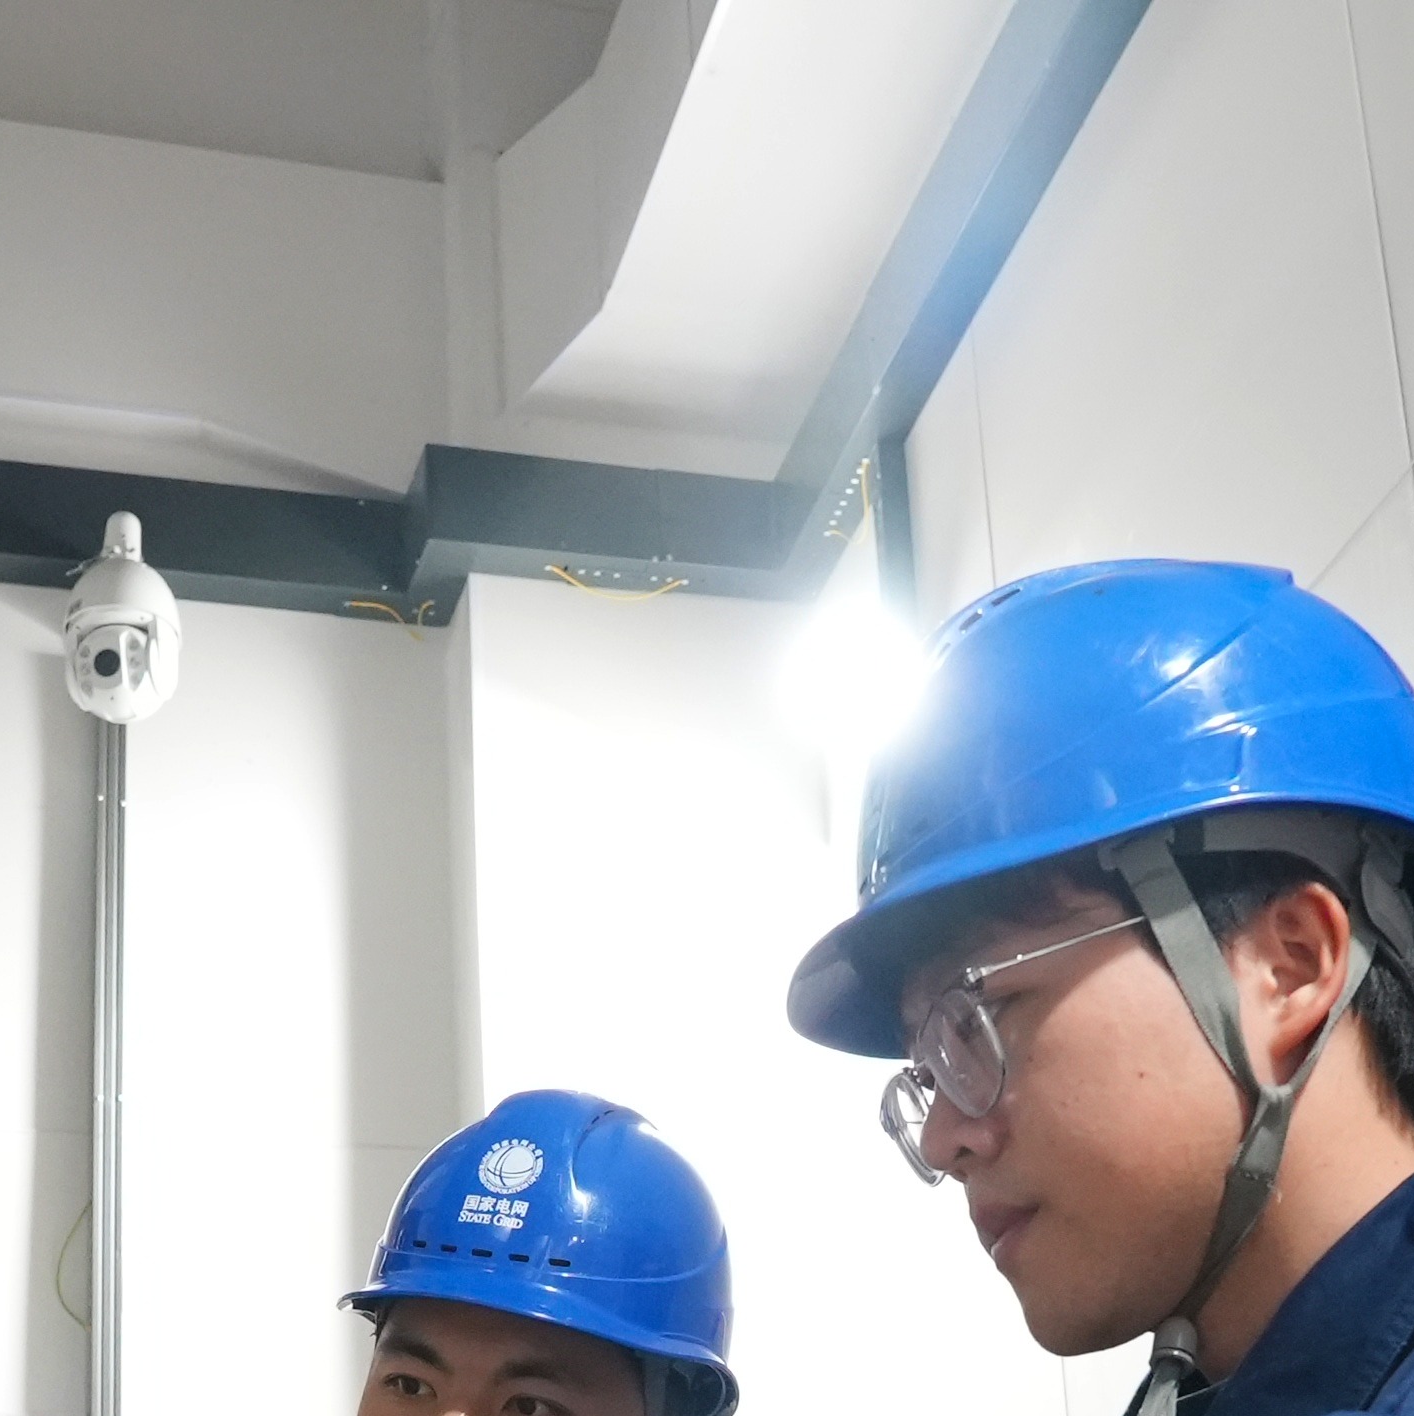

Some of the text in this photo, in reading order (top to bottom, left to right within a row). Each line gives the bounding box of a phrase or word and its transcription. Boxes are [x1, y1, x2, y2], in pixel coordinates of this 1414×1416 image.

[462, 1194, 529, 1217] 国家电网
[458, 1211, 524, 1229] STATE GRID
